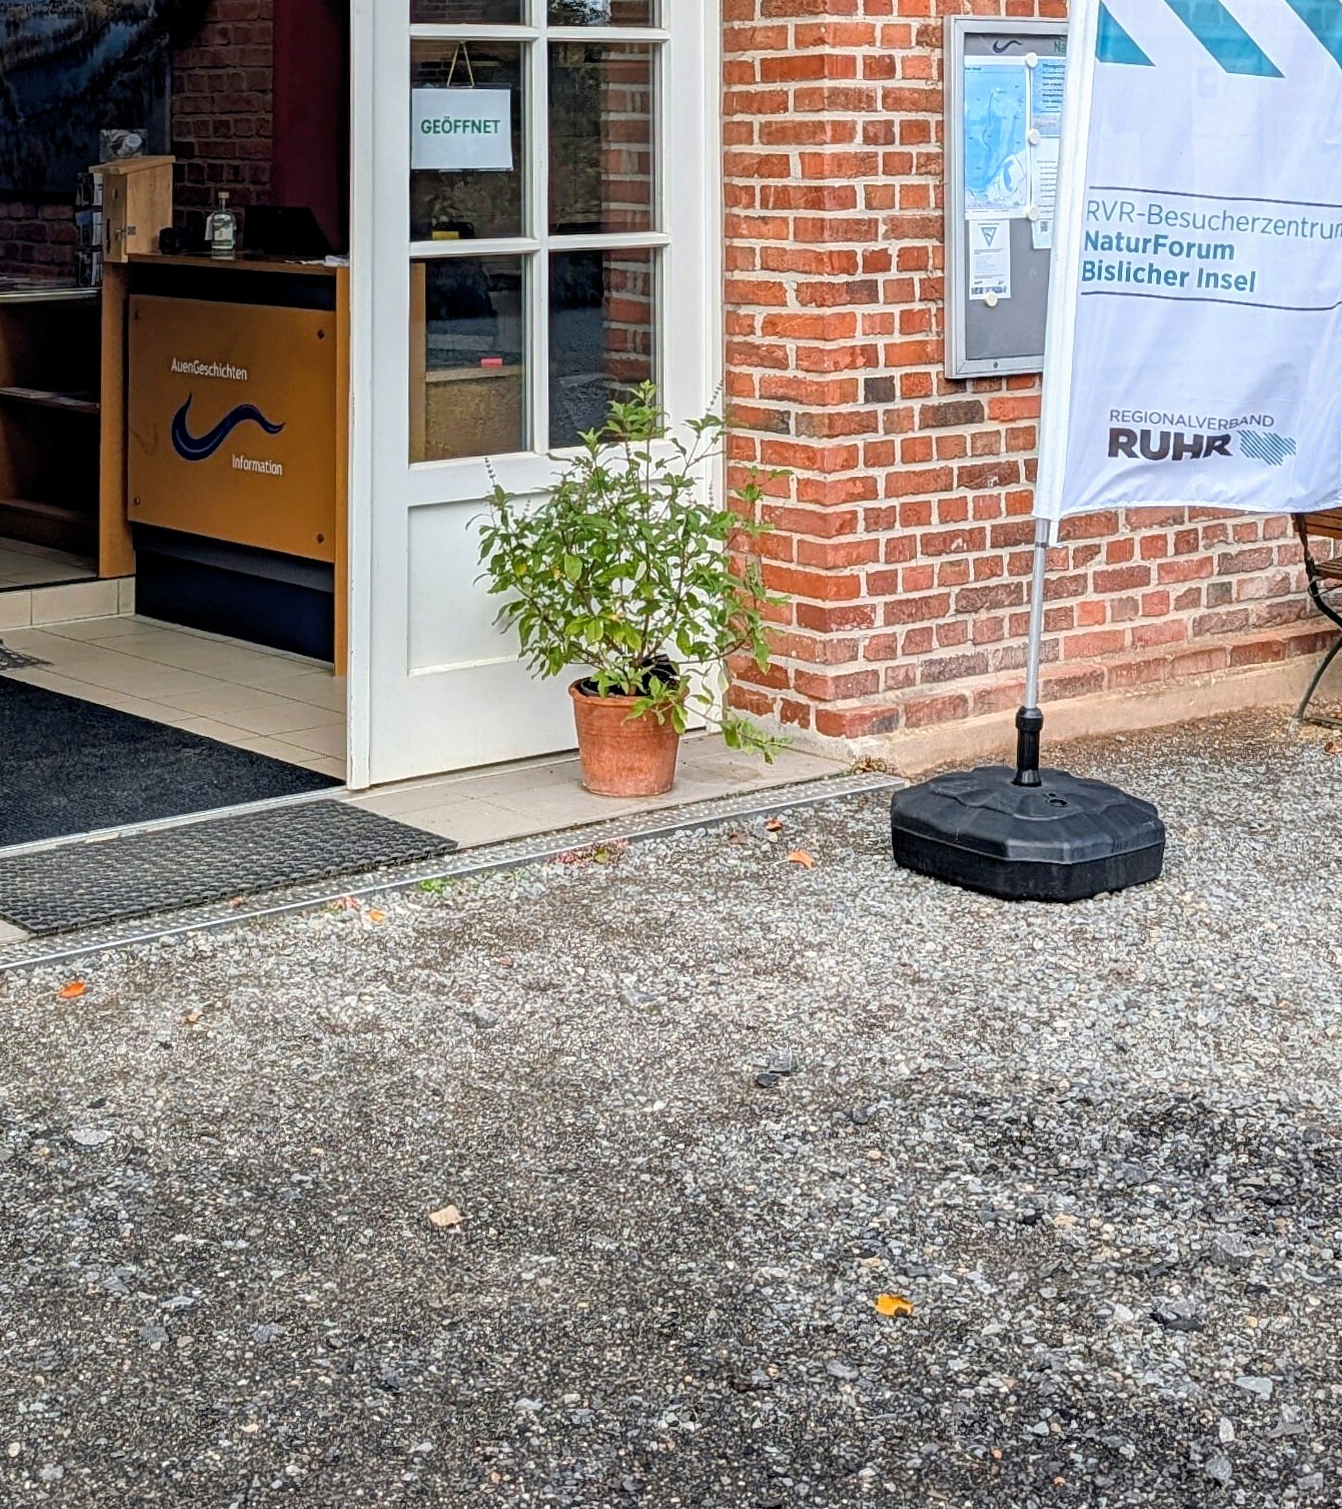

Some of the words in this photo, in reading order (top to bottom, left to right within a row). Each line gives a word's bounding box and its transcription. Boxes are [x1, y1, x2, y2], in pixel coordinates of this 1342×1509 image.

[420, 116, 501, 135] GEÖFFNET
[1084, 229, 1236, 261] NaturForum
[1081, 259, 1190, 289] Bislicher
[1197, 267, 1257, 293] Insel
[171, 358, 247, 381] AuenGeschichten
[1109, 409, 1275, 432] REGIONALVERBAND
[1107, 427, 1233, 461] RUHR
[232, 454, 283, 476] Information
